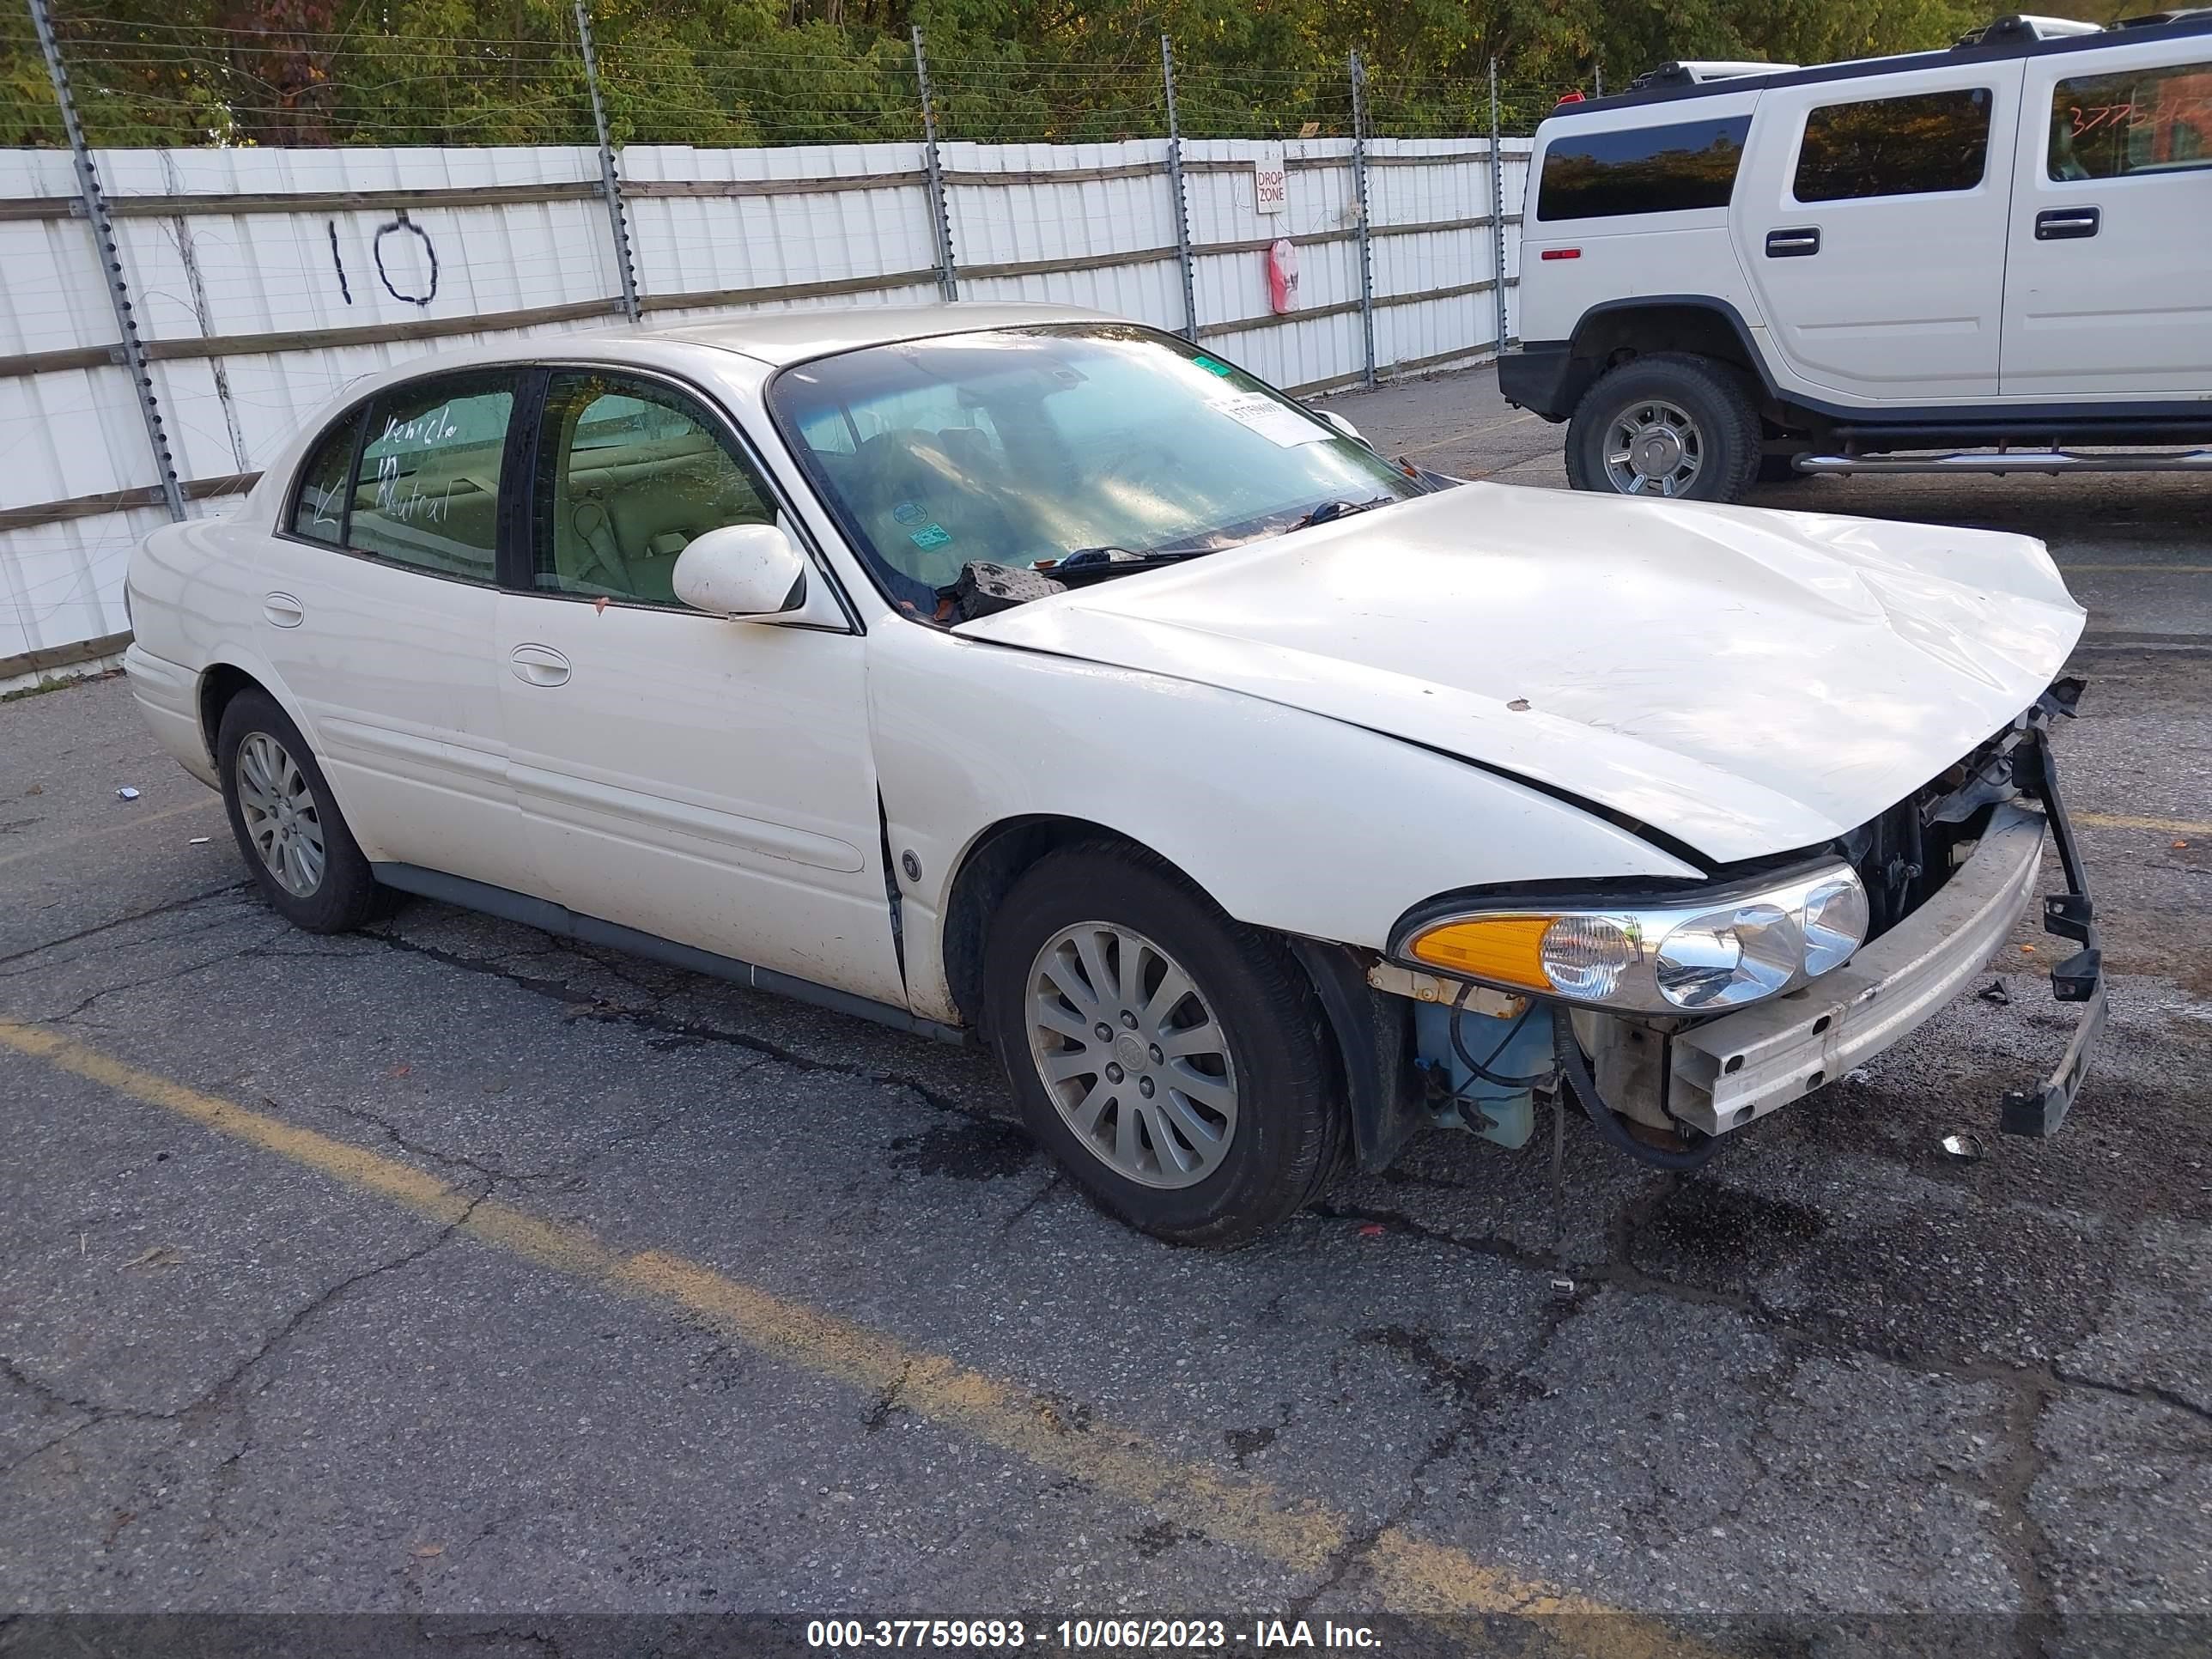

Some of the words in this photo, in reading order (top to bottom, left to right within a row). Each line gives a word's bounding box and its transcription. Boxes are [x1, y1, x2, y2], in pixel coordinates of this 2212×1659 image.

[1258, 172, 1283, 185] DROP
[1259, 187, 1285, 202] ZONE
[328, 218, 438, 307] 10
[378, 447, 398, 480] in
